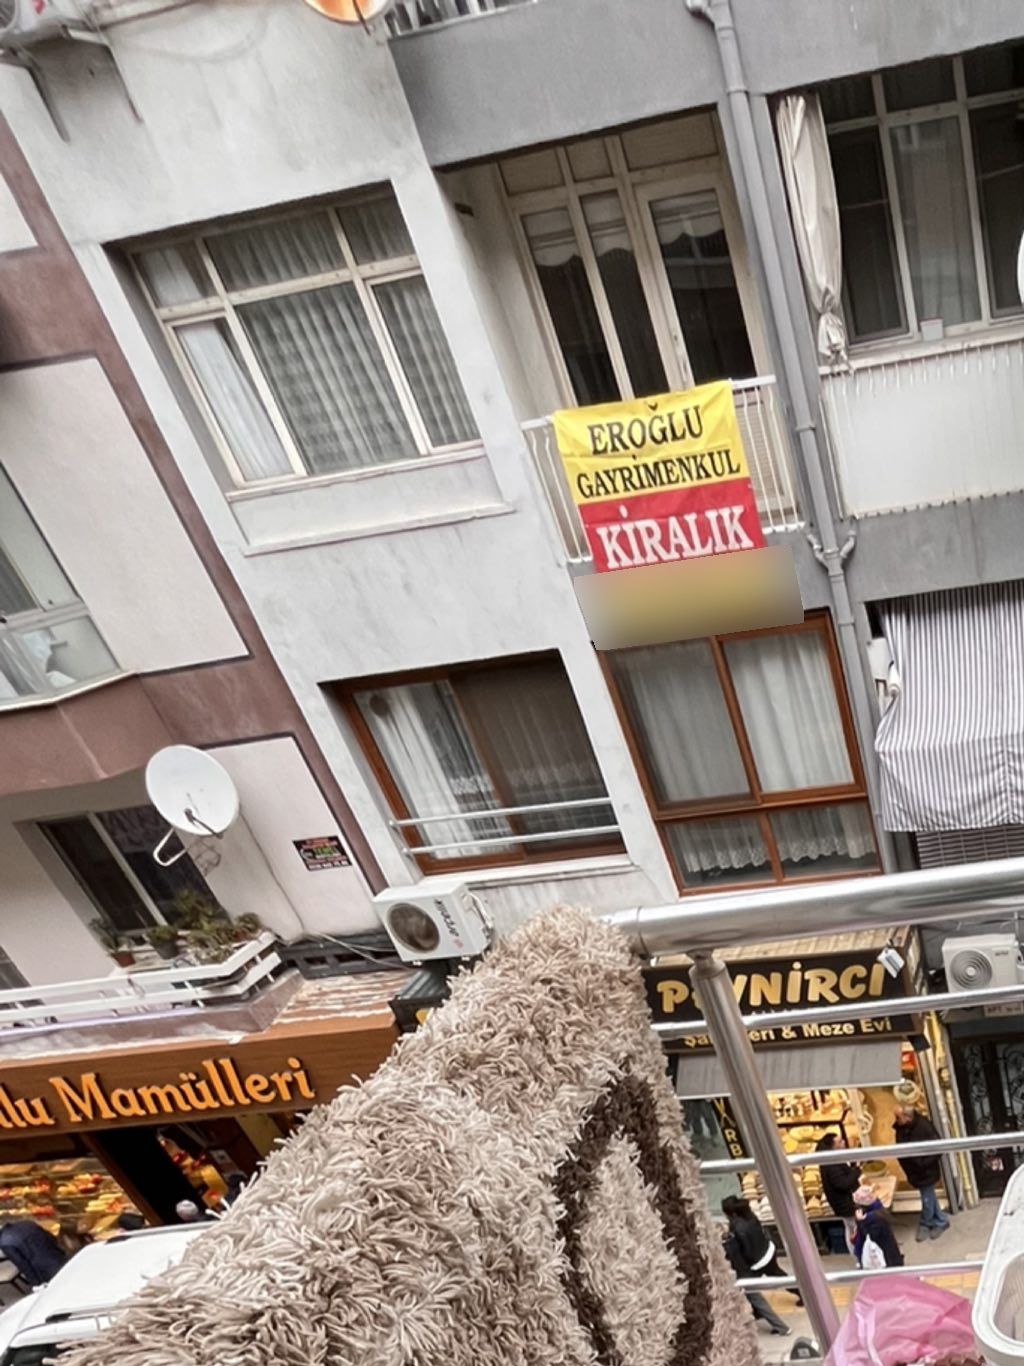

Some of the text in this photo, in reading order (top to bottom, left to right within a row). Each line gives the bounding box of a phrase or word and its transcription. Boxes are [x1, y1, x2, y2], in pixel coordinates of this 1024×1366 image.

[588, 402, 704, 456] EROĞLU
[577, 449, 741, 499] GAYRİMENKUL
[596, 505, 753, 570] KİRALIK
[781, 1025, 797, 1040] &
[803, 1020, 855, 1039] Meze
[860, 1016, 893, 1033] Evi
[48, 1057, 315, 1124] Mamülleri
